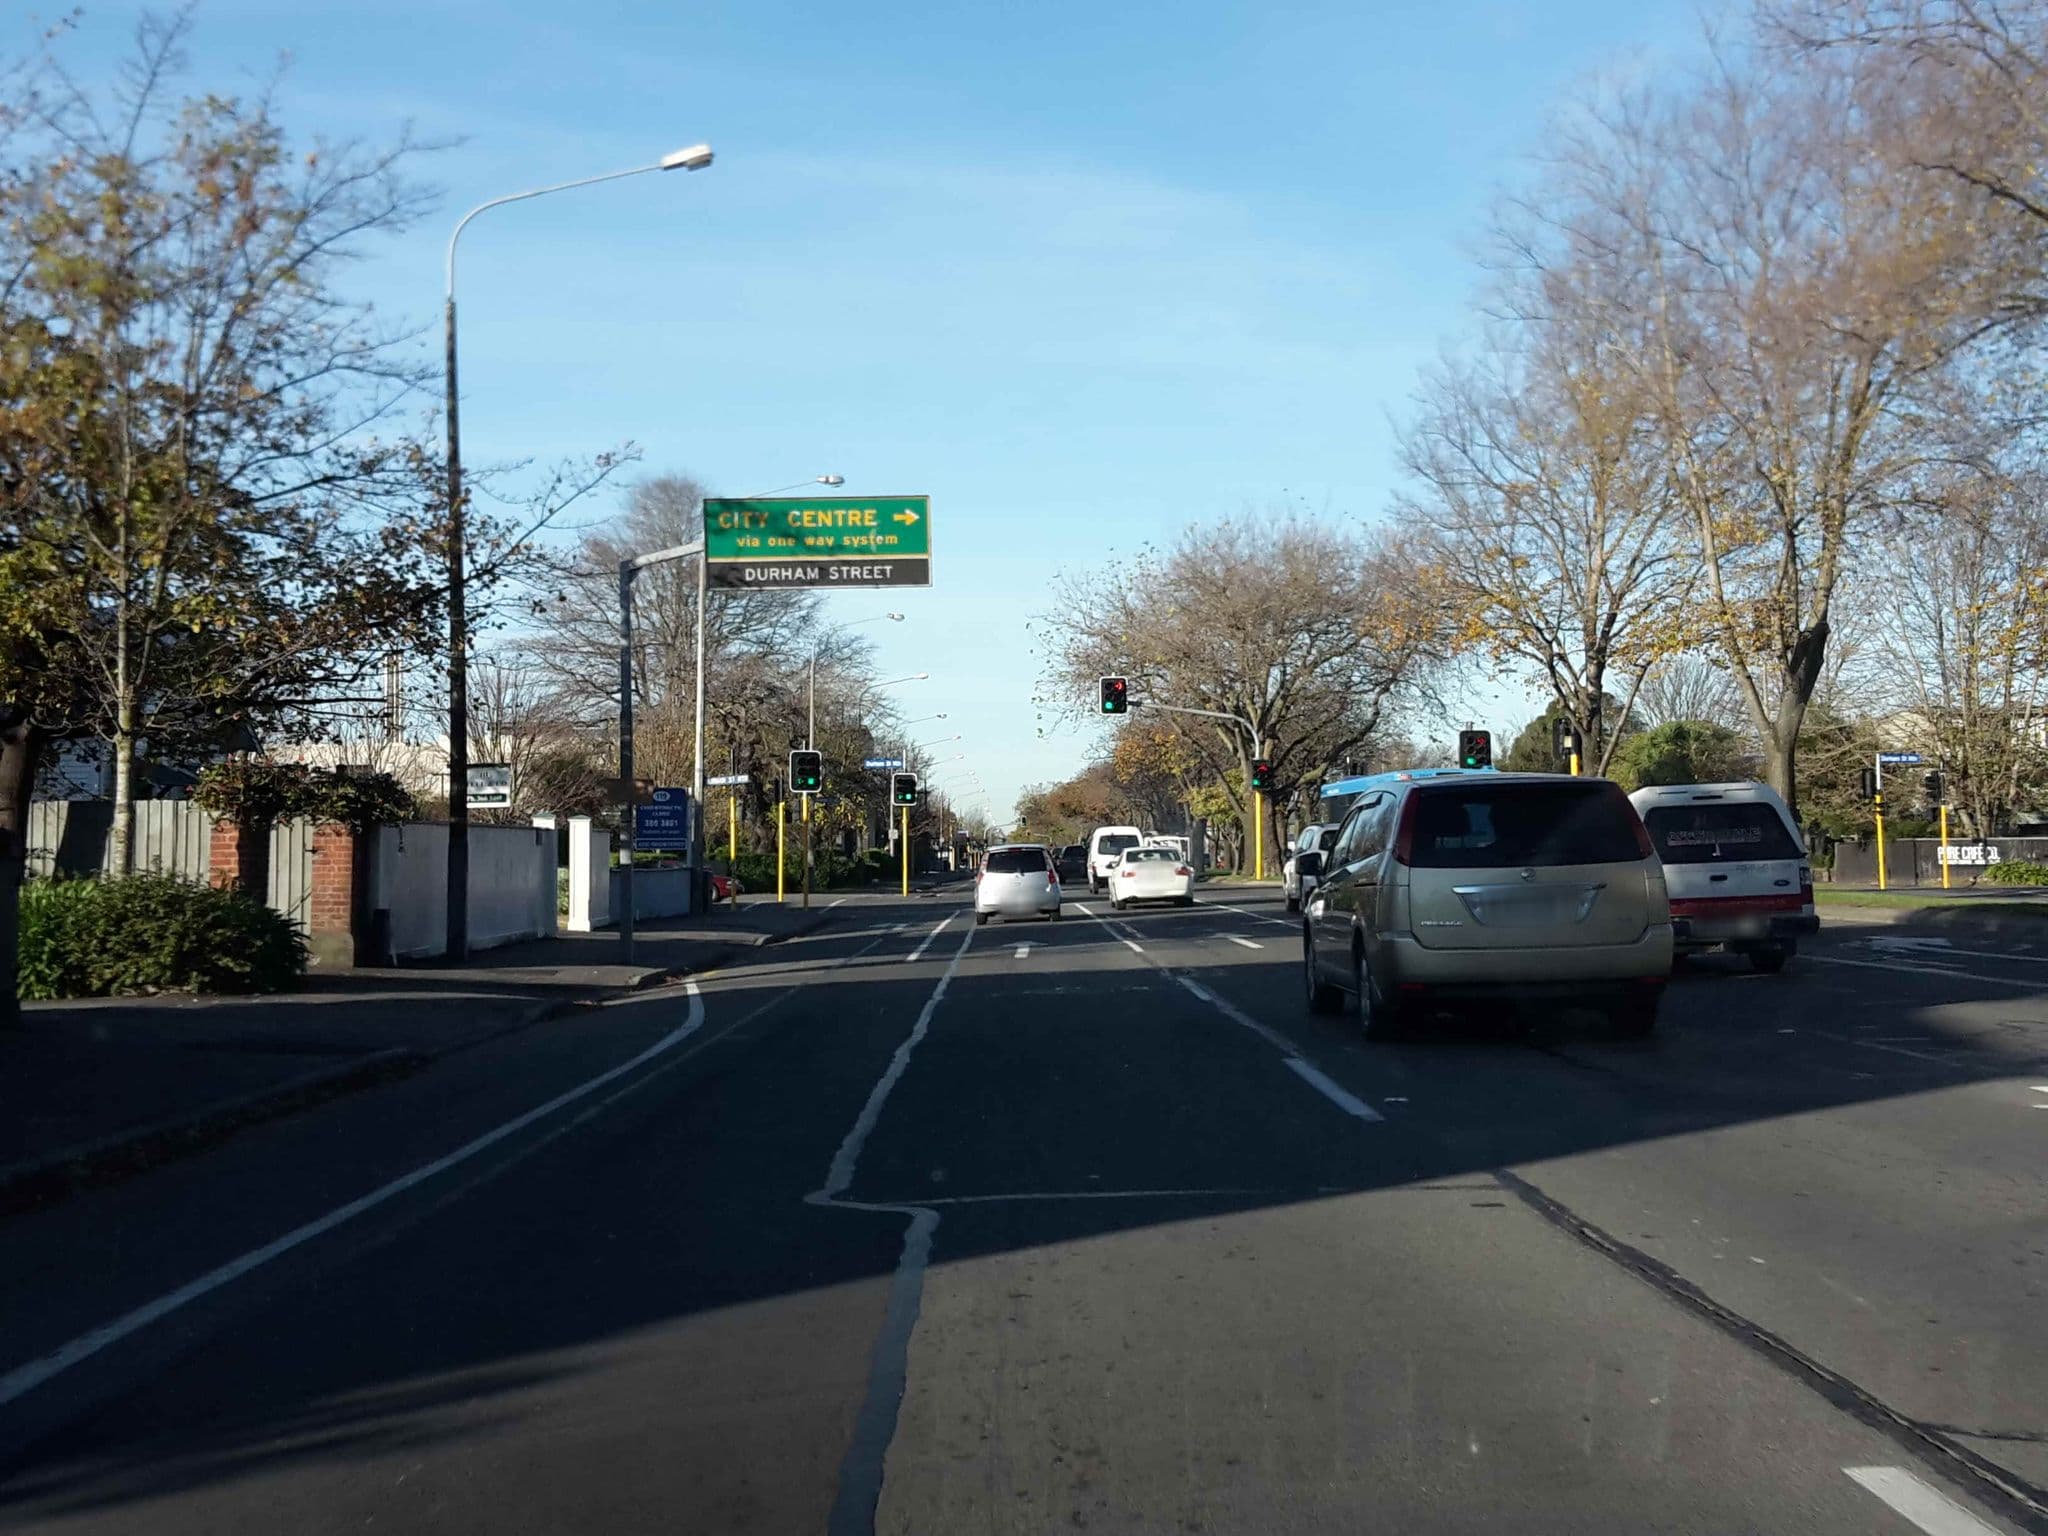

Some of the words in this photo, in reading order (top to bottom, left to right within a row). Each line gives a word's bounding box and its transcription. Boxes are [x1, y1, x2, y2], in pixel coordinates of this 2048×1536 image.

[718, 511, 769, 529] CITY
[787, 509, 878, 528] CENTRE
[736, 534, 760, 547] via
[767, 537, 796, 547] one
[804, 536, 834, 548] way
[842, 533, 898, 548] system
[745, 567, 819, 582] DURHAM
[828, 566, 893, 580] STREET
